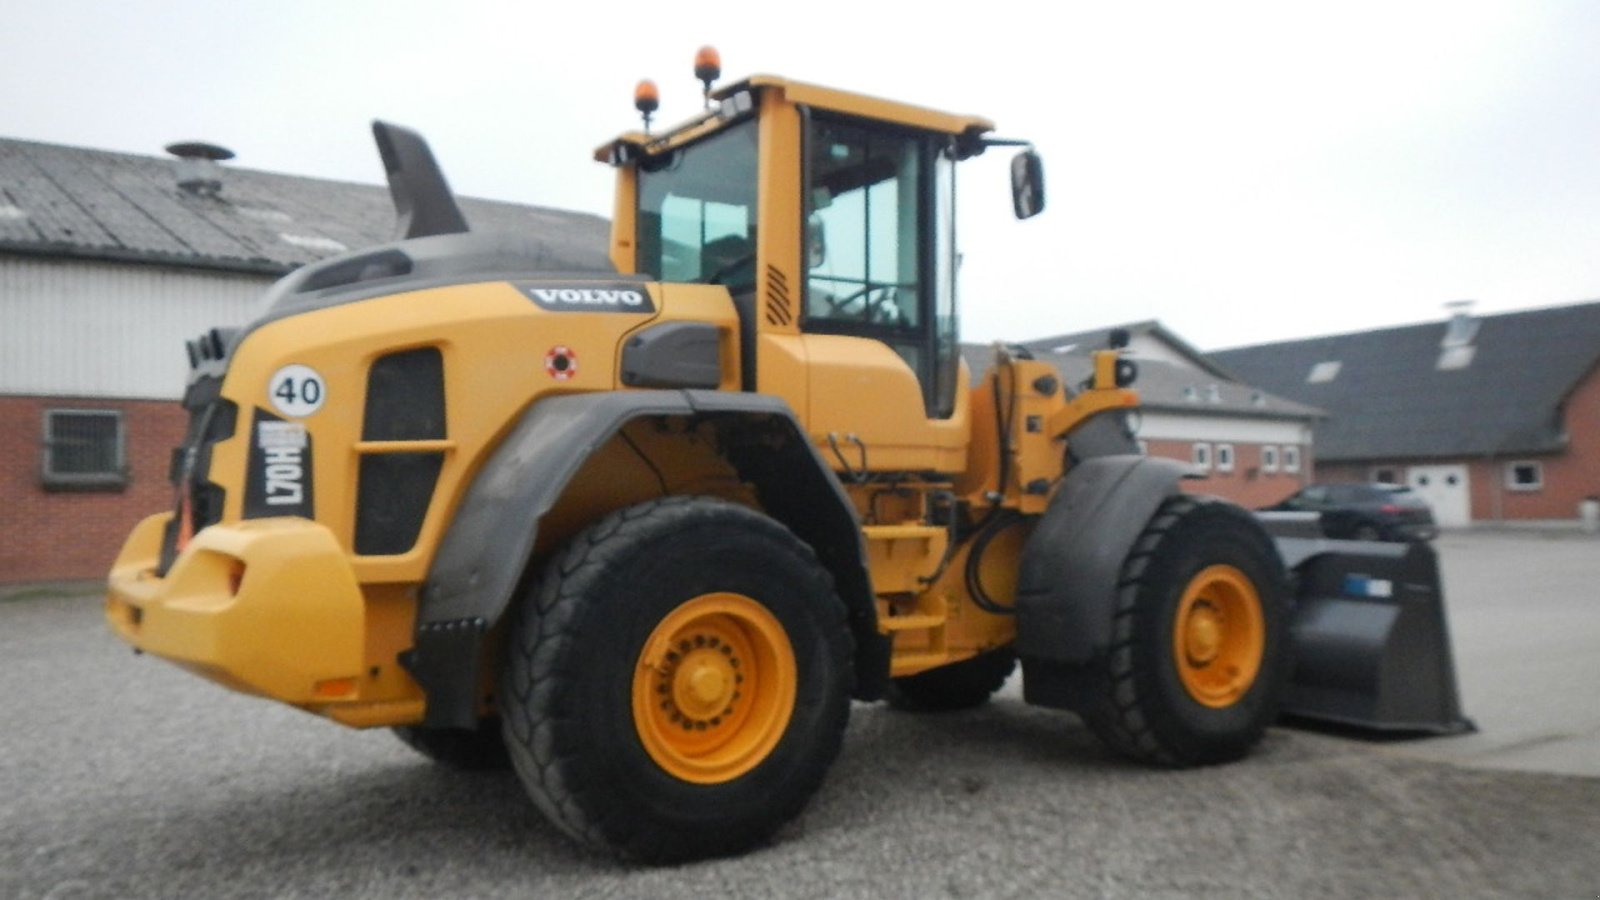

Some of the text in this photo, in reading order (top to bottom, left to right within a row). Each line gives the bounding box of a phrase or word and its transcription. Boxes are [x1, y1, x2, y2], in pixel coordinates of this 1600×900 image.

[530, 288, 643, 306] VOLVO
[275, 377, 320, 404] 40
[265, 448, 303, 505] L70H
